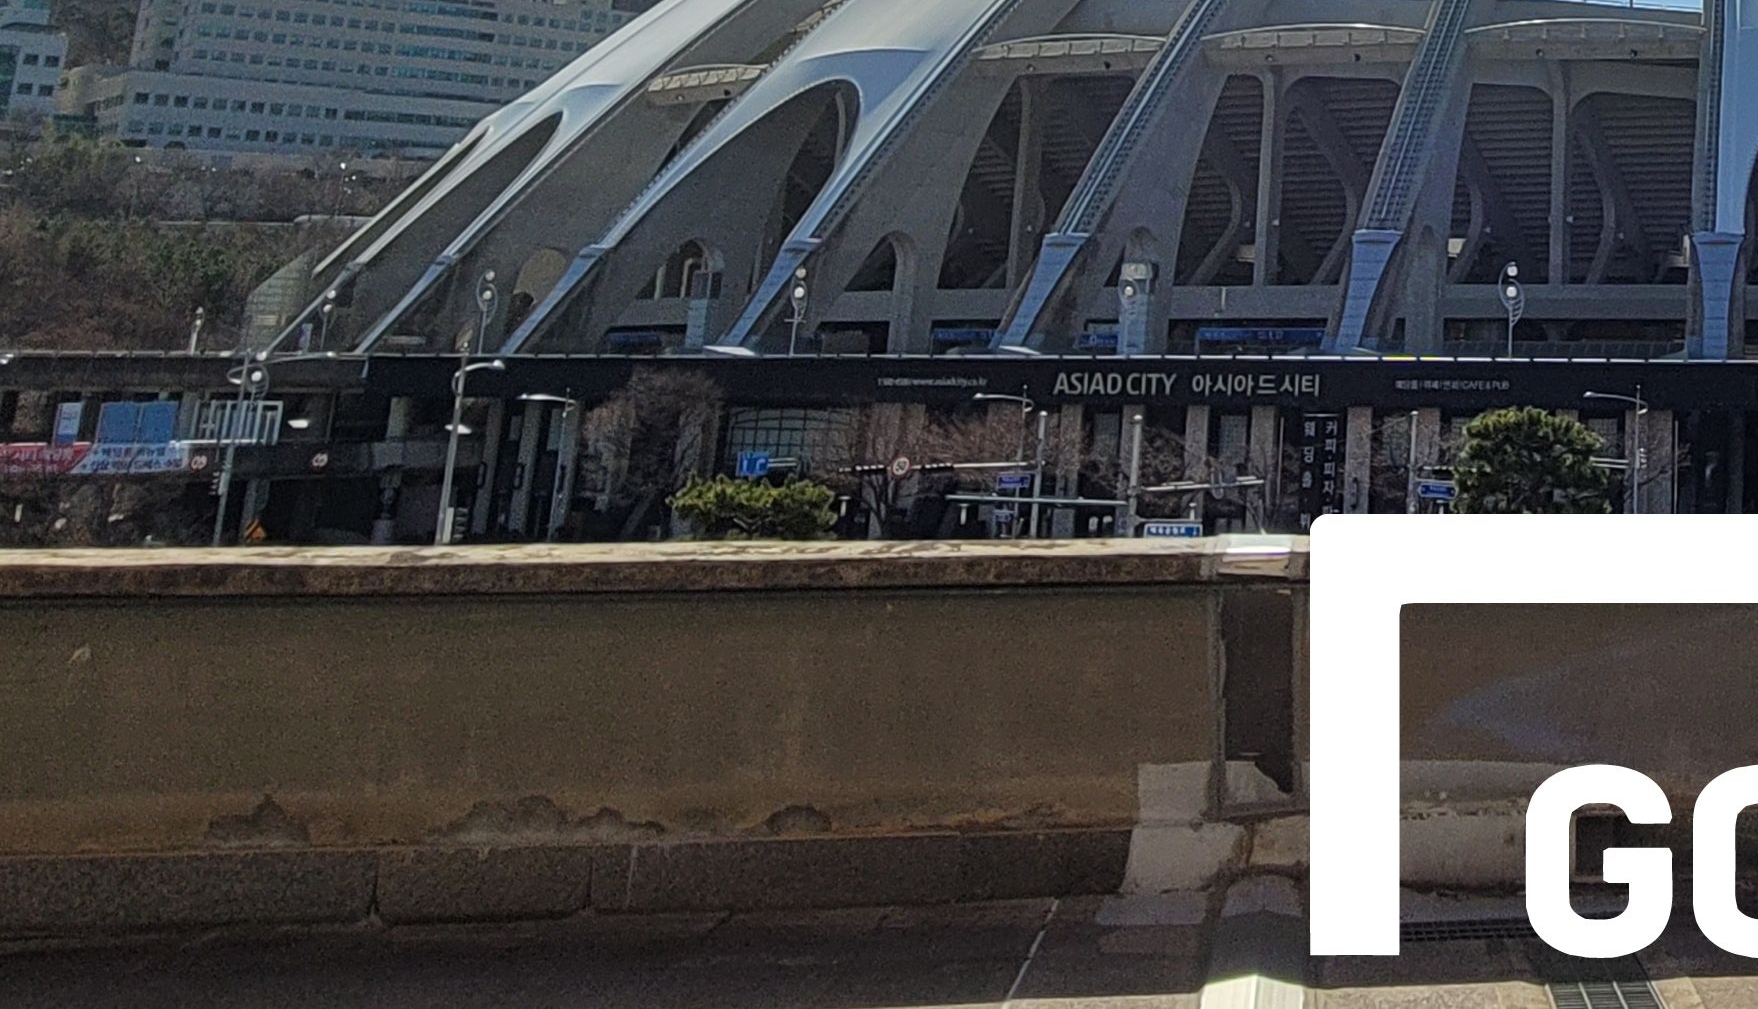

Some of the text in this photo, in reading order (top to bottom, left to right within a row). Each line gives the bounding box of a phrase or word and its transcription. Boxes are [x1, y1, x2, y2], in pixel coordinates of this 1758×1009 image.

[1052, 372, 1177, 396] ASIAD CITY
[1192, 373, 1320, 397] 아시아드시티
